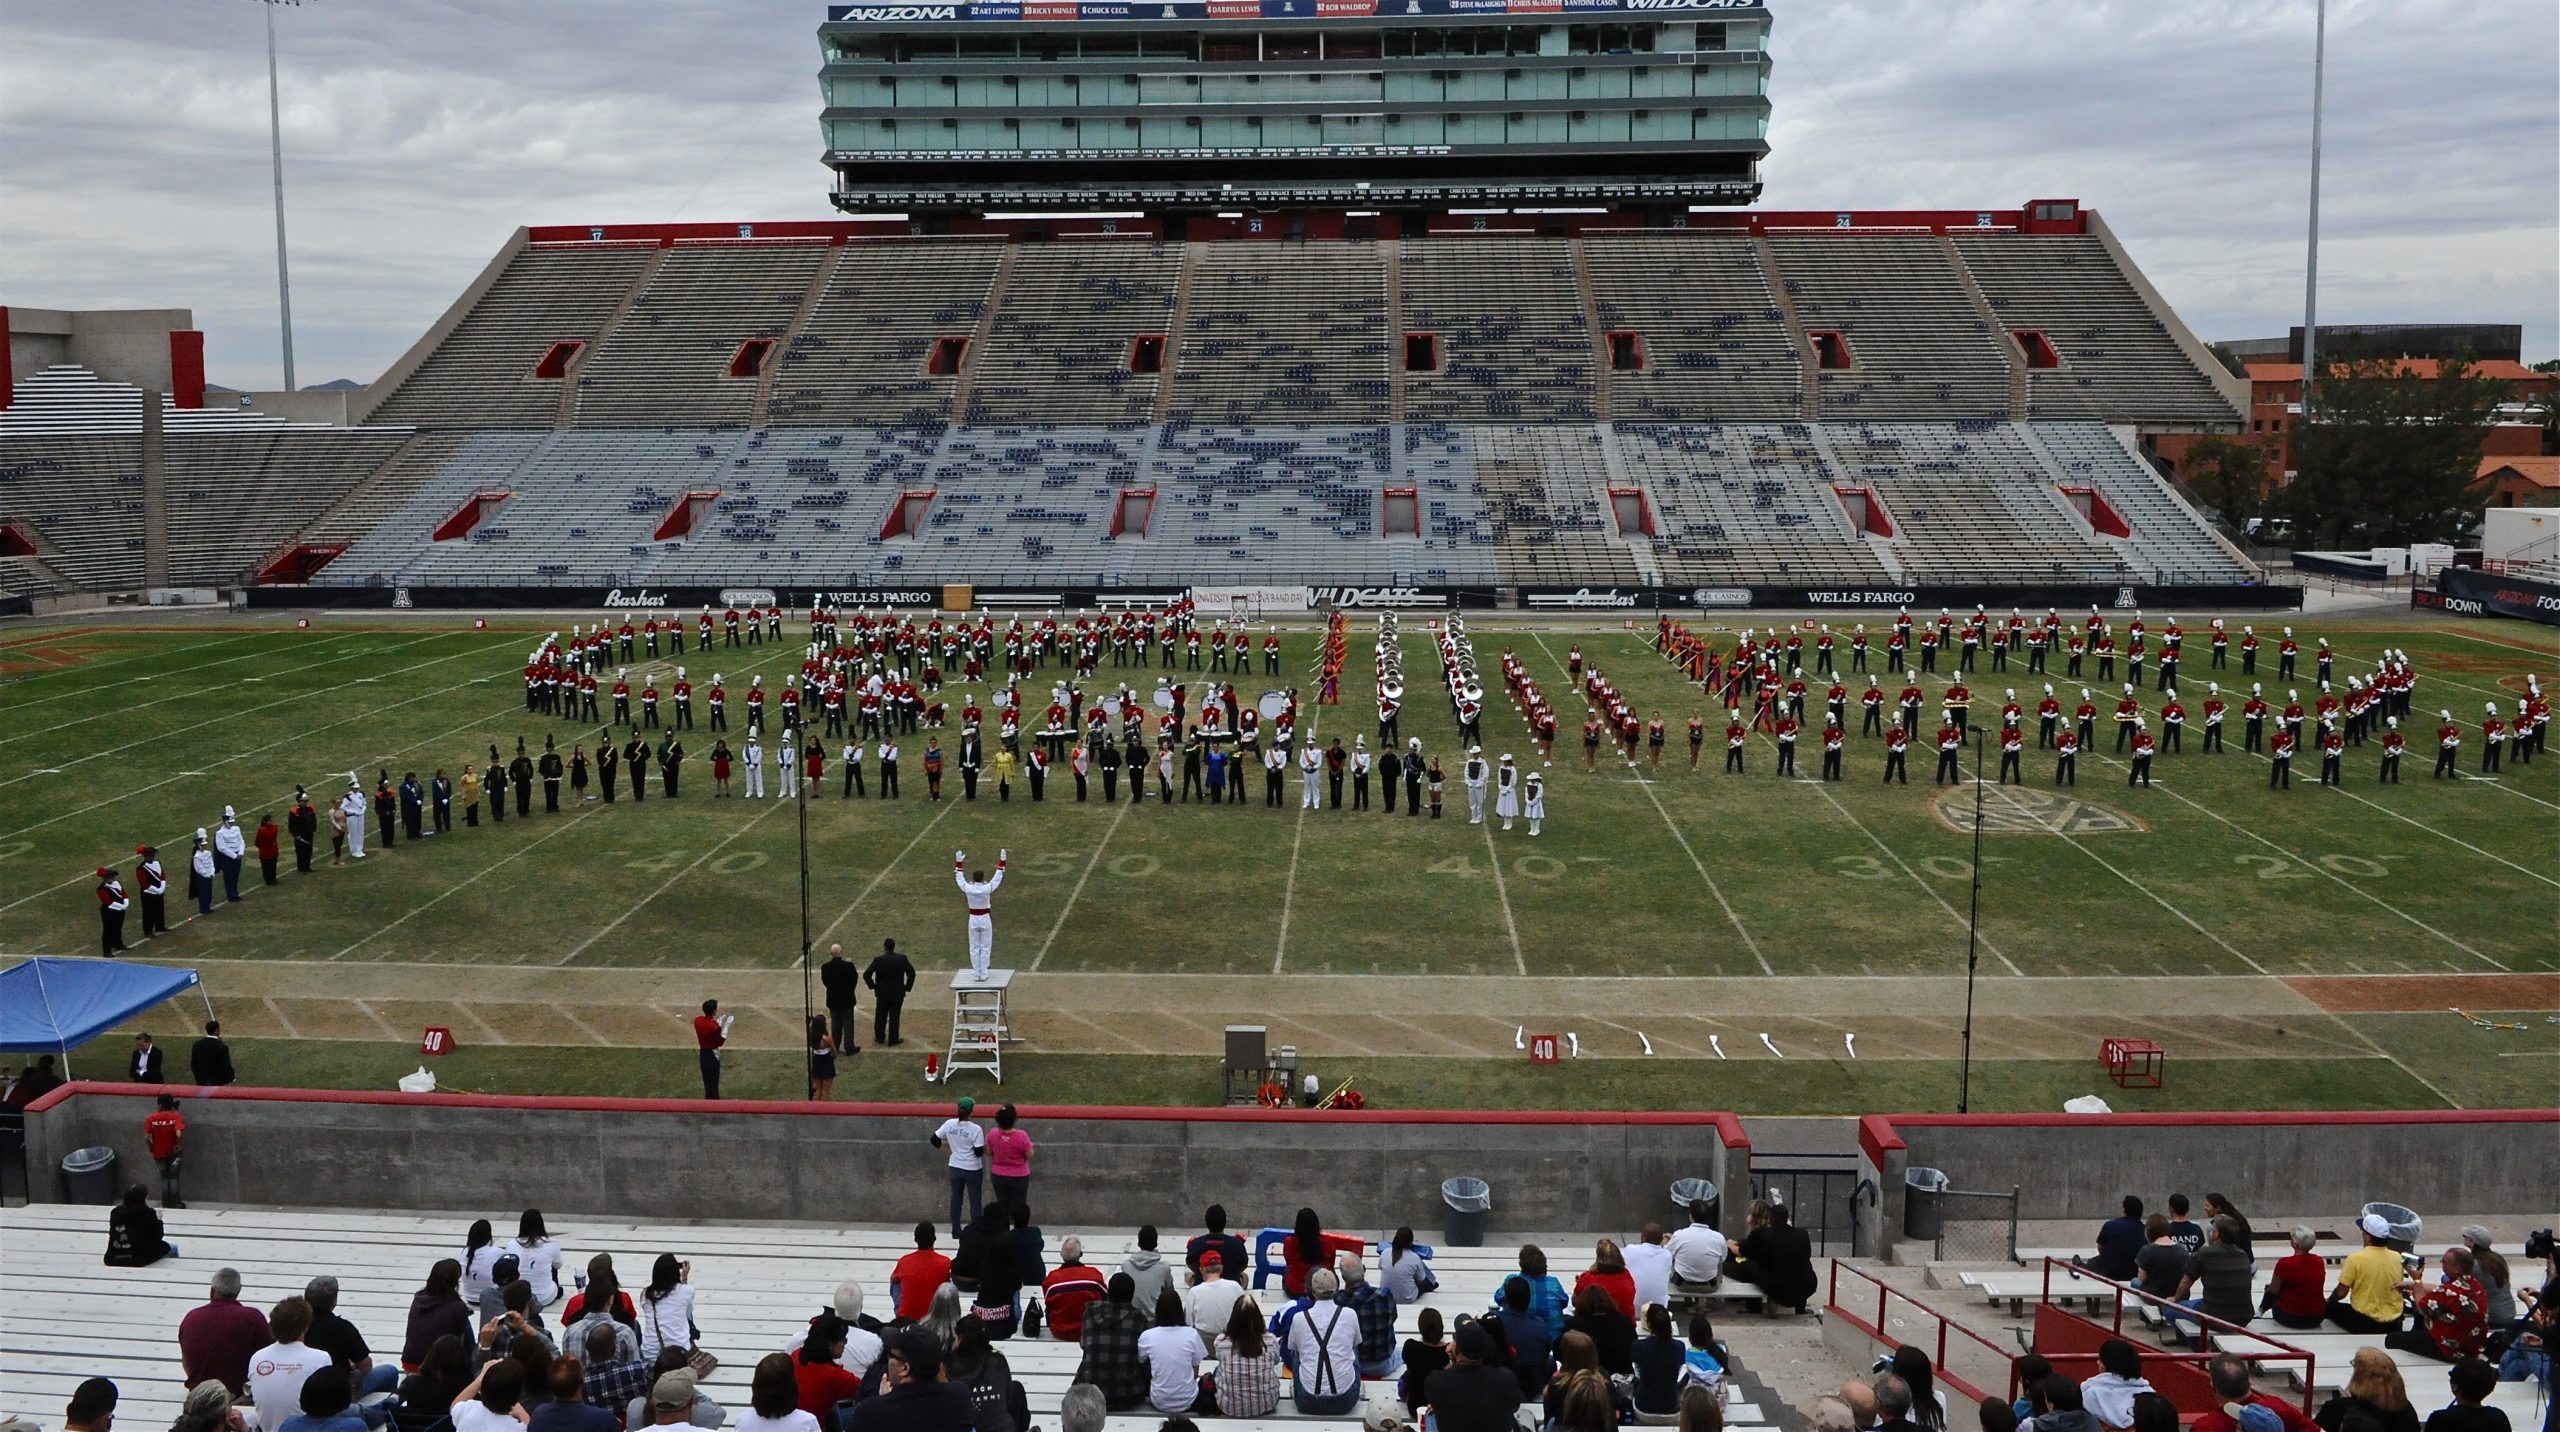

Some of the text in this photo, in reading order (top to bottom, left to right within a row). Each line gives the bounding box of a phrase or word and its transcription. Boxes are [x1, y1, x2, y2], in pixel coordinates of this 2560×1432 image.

[1241, 5, 1260, 13] LEWIS
[1627, 0, 1754, 9] WILDCATS
[842, 7, 956, 20] ARIZONA
[1474, 221, 1487, 230] 22
[1674, 219, 1686, 228] 23
[1837, 218, 1850, 228] 24
[1978, 217, 1991, 227] 25
[911, 227, 921, 236] 19
[1103, 225, 1116, 234] 20
[1250, 223, 1262, 232] 21
[592, 232, 603, 241] 17
[740, 229, 752, 239] 18
[241, 396, 252, 405] 16
[604, 589, 668, 606] Bashas'
[829, 592, 931, 603] WELLS FARGO
[1195, 593, 1230, 603] UNIVERSITY
[1271, 594, 1290, 603] BAND
[1291, 593, 1305, 603] DAY
[1808, 592, 1915, 603] WELLS FARGO
[2445, 597, 2483, 614] DOWN
[1426, 855, 1569, 879] 40
[1832, 856, 1978, 880] 30
[2234, 853, 2390, 879] 20
[425, 1031, 443, 1051] 40
[1535, 1039, 1553, 1059] 40
[2171, 1235, 2199, 1244] BAND
